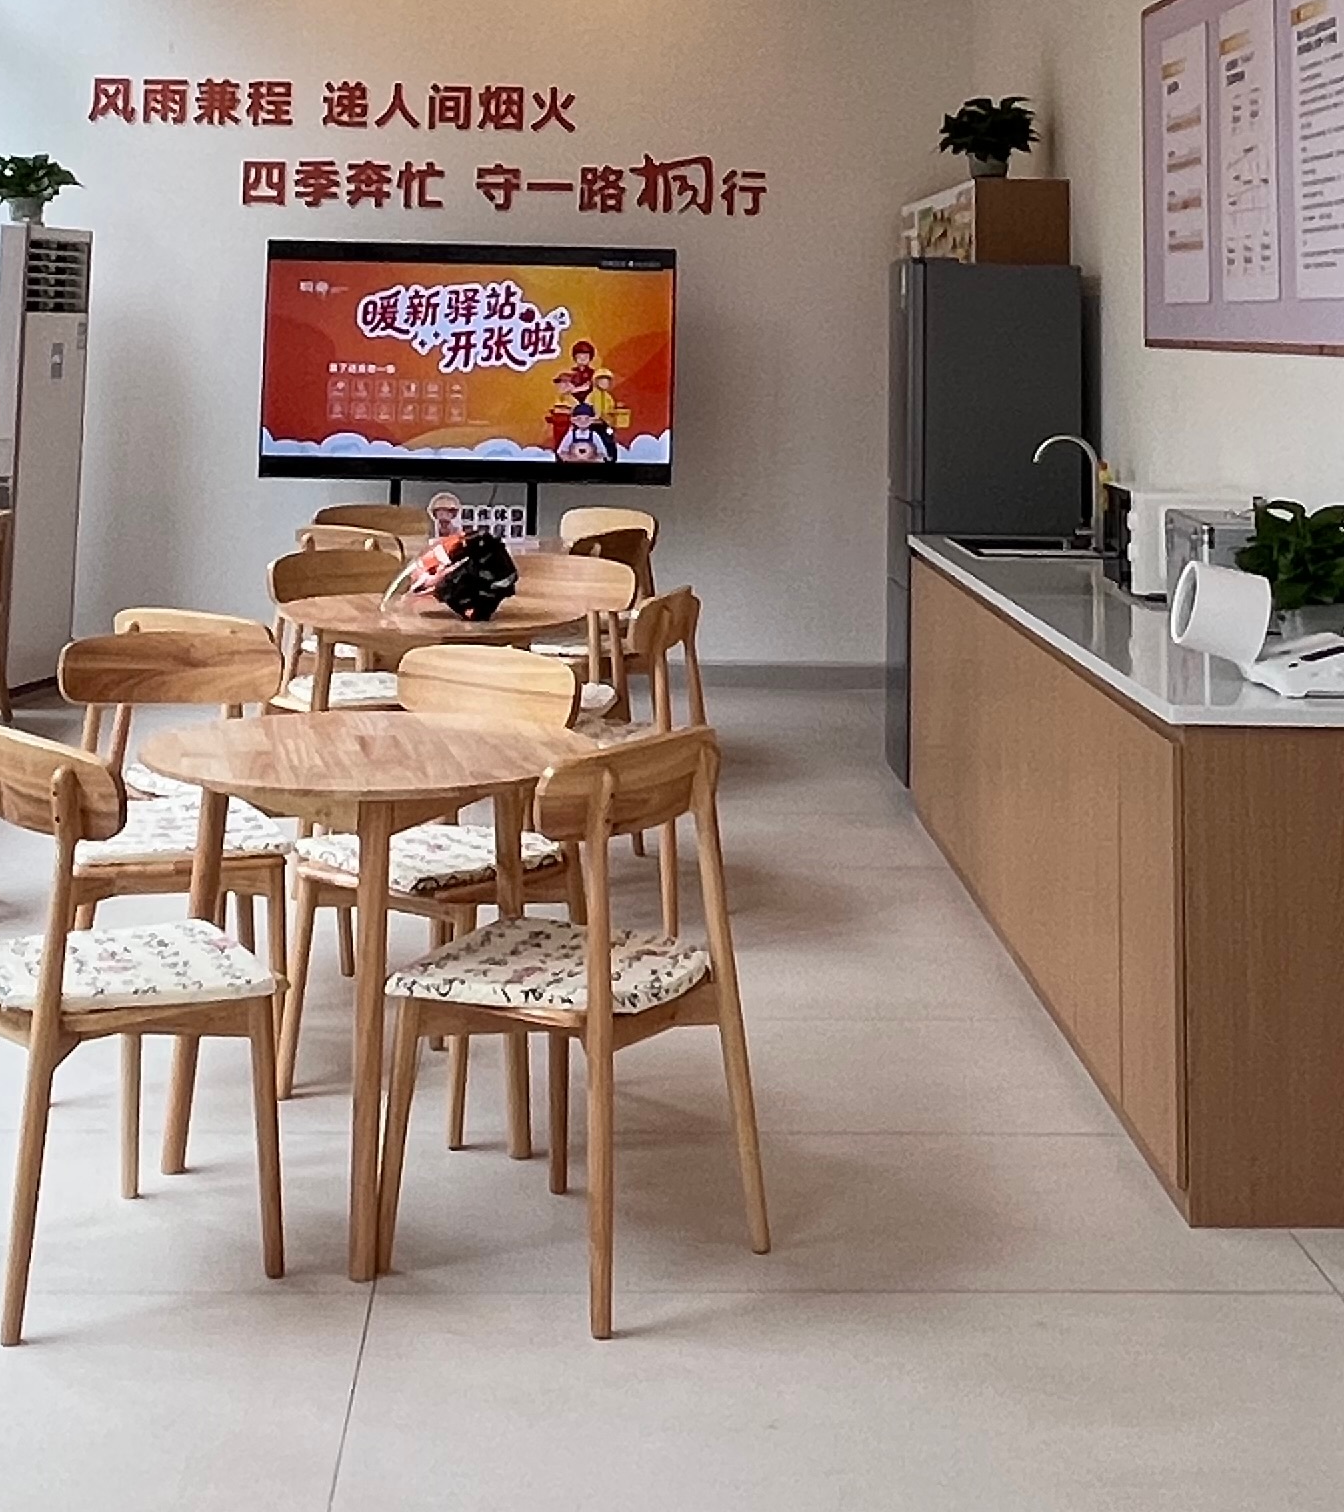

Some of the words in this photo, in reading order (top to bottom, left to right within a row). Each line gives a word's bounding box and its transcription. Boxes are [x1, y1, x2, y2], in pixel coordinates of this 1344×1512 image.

[87, 78, 294, 127] 风雨兼程
[321, 81, 576, 133] 递人间烟火
[240, 159, 445, 211] 四季奔忙
[362, 285, 517, 335] 暖新驿站
[444, 322, 558, 368] 开张啦
